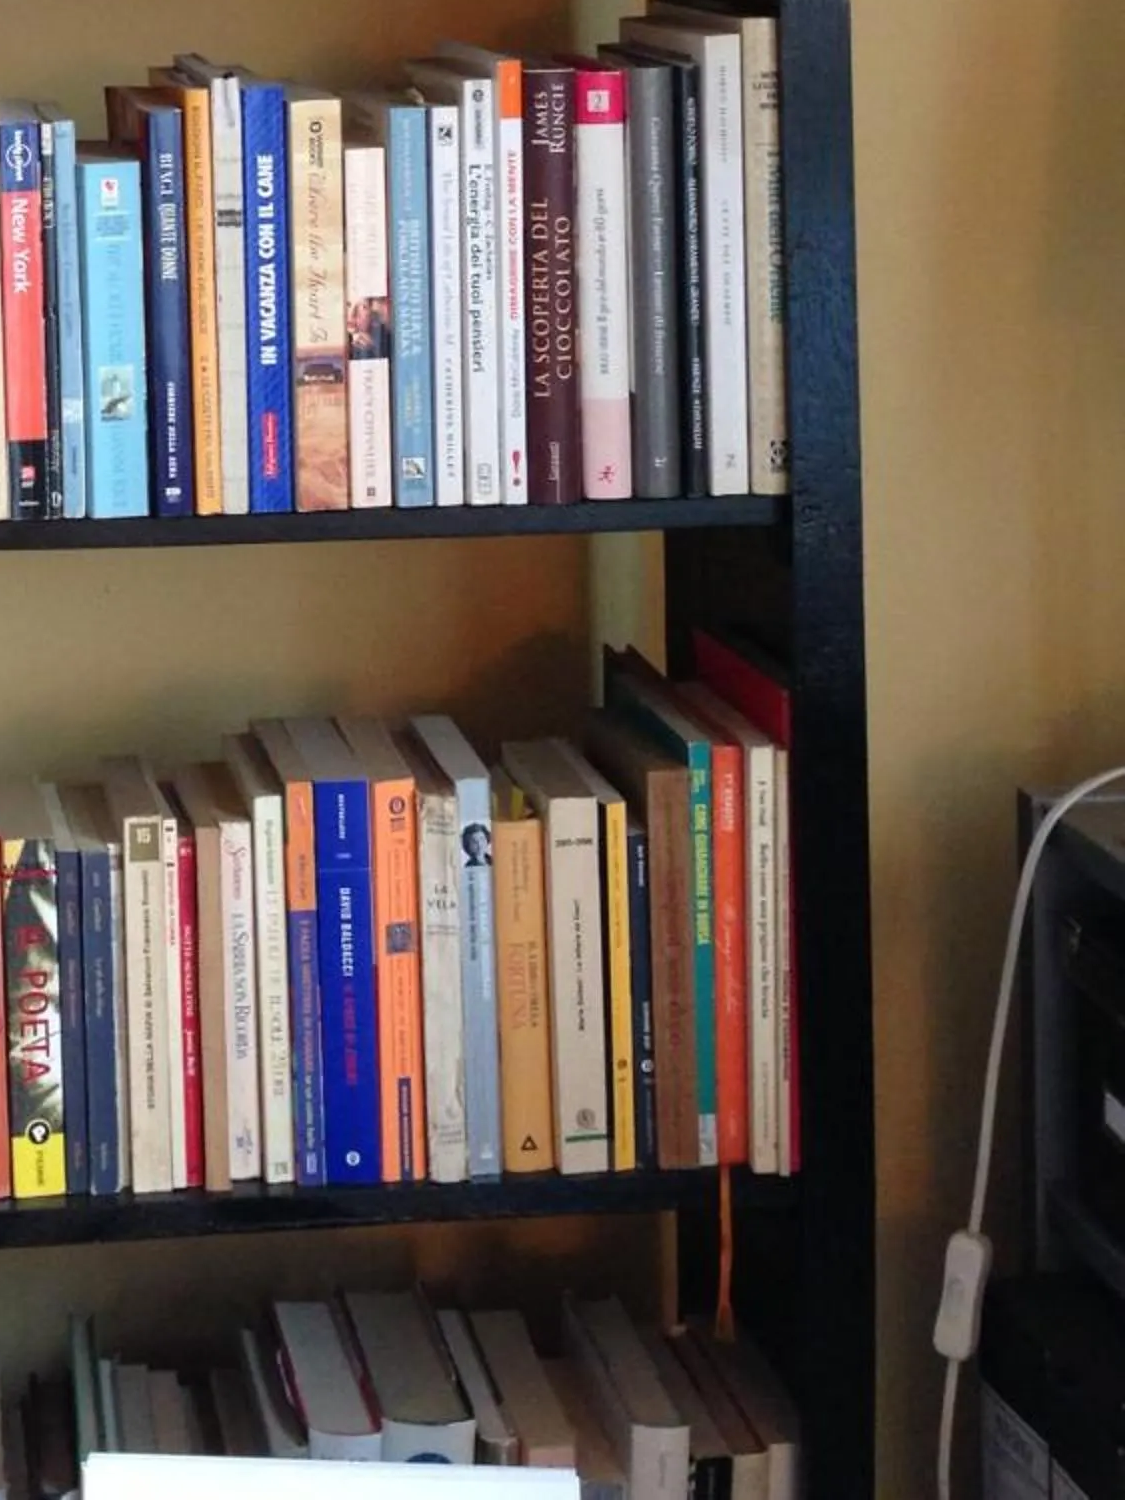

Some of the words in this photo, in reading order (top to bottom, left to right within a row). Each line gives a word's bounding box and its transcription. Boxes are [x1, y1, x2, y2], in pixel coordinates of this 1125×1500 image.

[531, 90, 551, 145] JAMES
[548, 82, 566, 153] RUNCIE
[255, 153, 274, 198] CANE
[11, 199, 30, 243] New
[257, 202, 275, 218] IL
[466, 164, 483, 239] L'energia
[530, 197, 549, 240] DEL
[257, 223, 275, 258] CON
[470, 243, 484, 270] dei
[12, 249, 32, 294] York
[470, 272, 485, 305] tuoi
[258, 263, 277, 341] VACANZA
[531, 247, 551, 364] SCOPERTA
[554, 216, 573, 380] CIOCCOLATO
[259, 346, 277, 365] IN
[466, 308, 485, 373] pensieri
[533, 372, 552, 398] LA
[339, 887, 353, 920] DAVID
[339, 923, 354, 977] BALDACCI
[18, 970, 51, 1085] POETA
